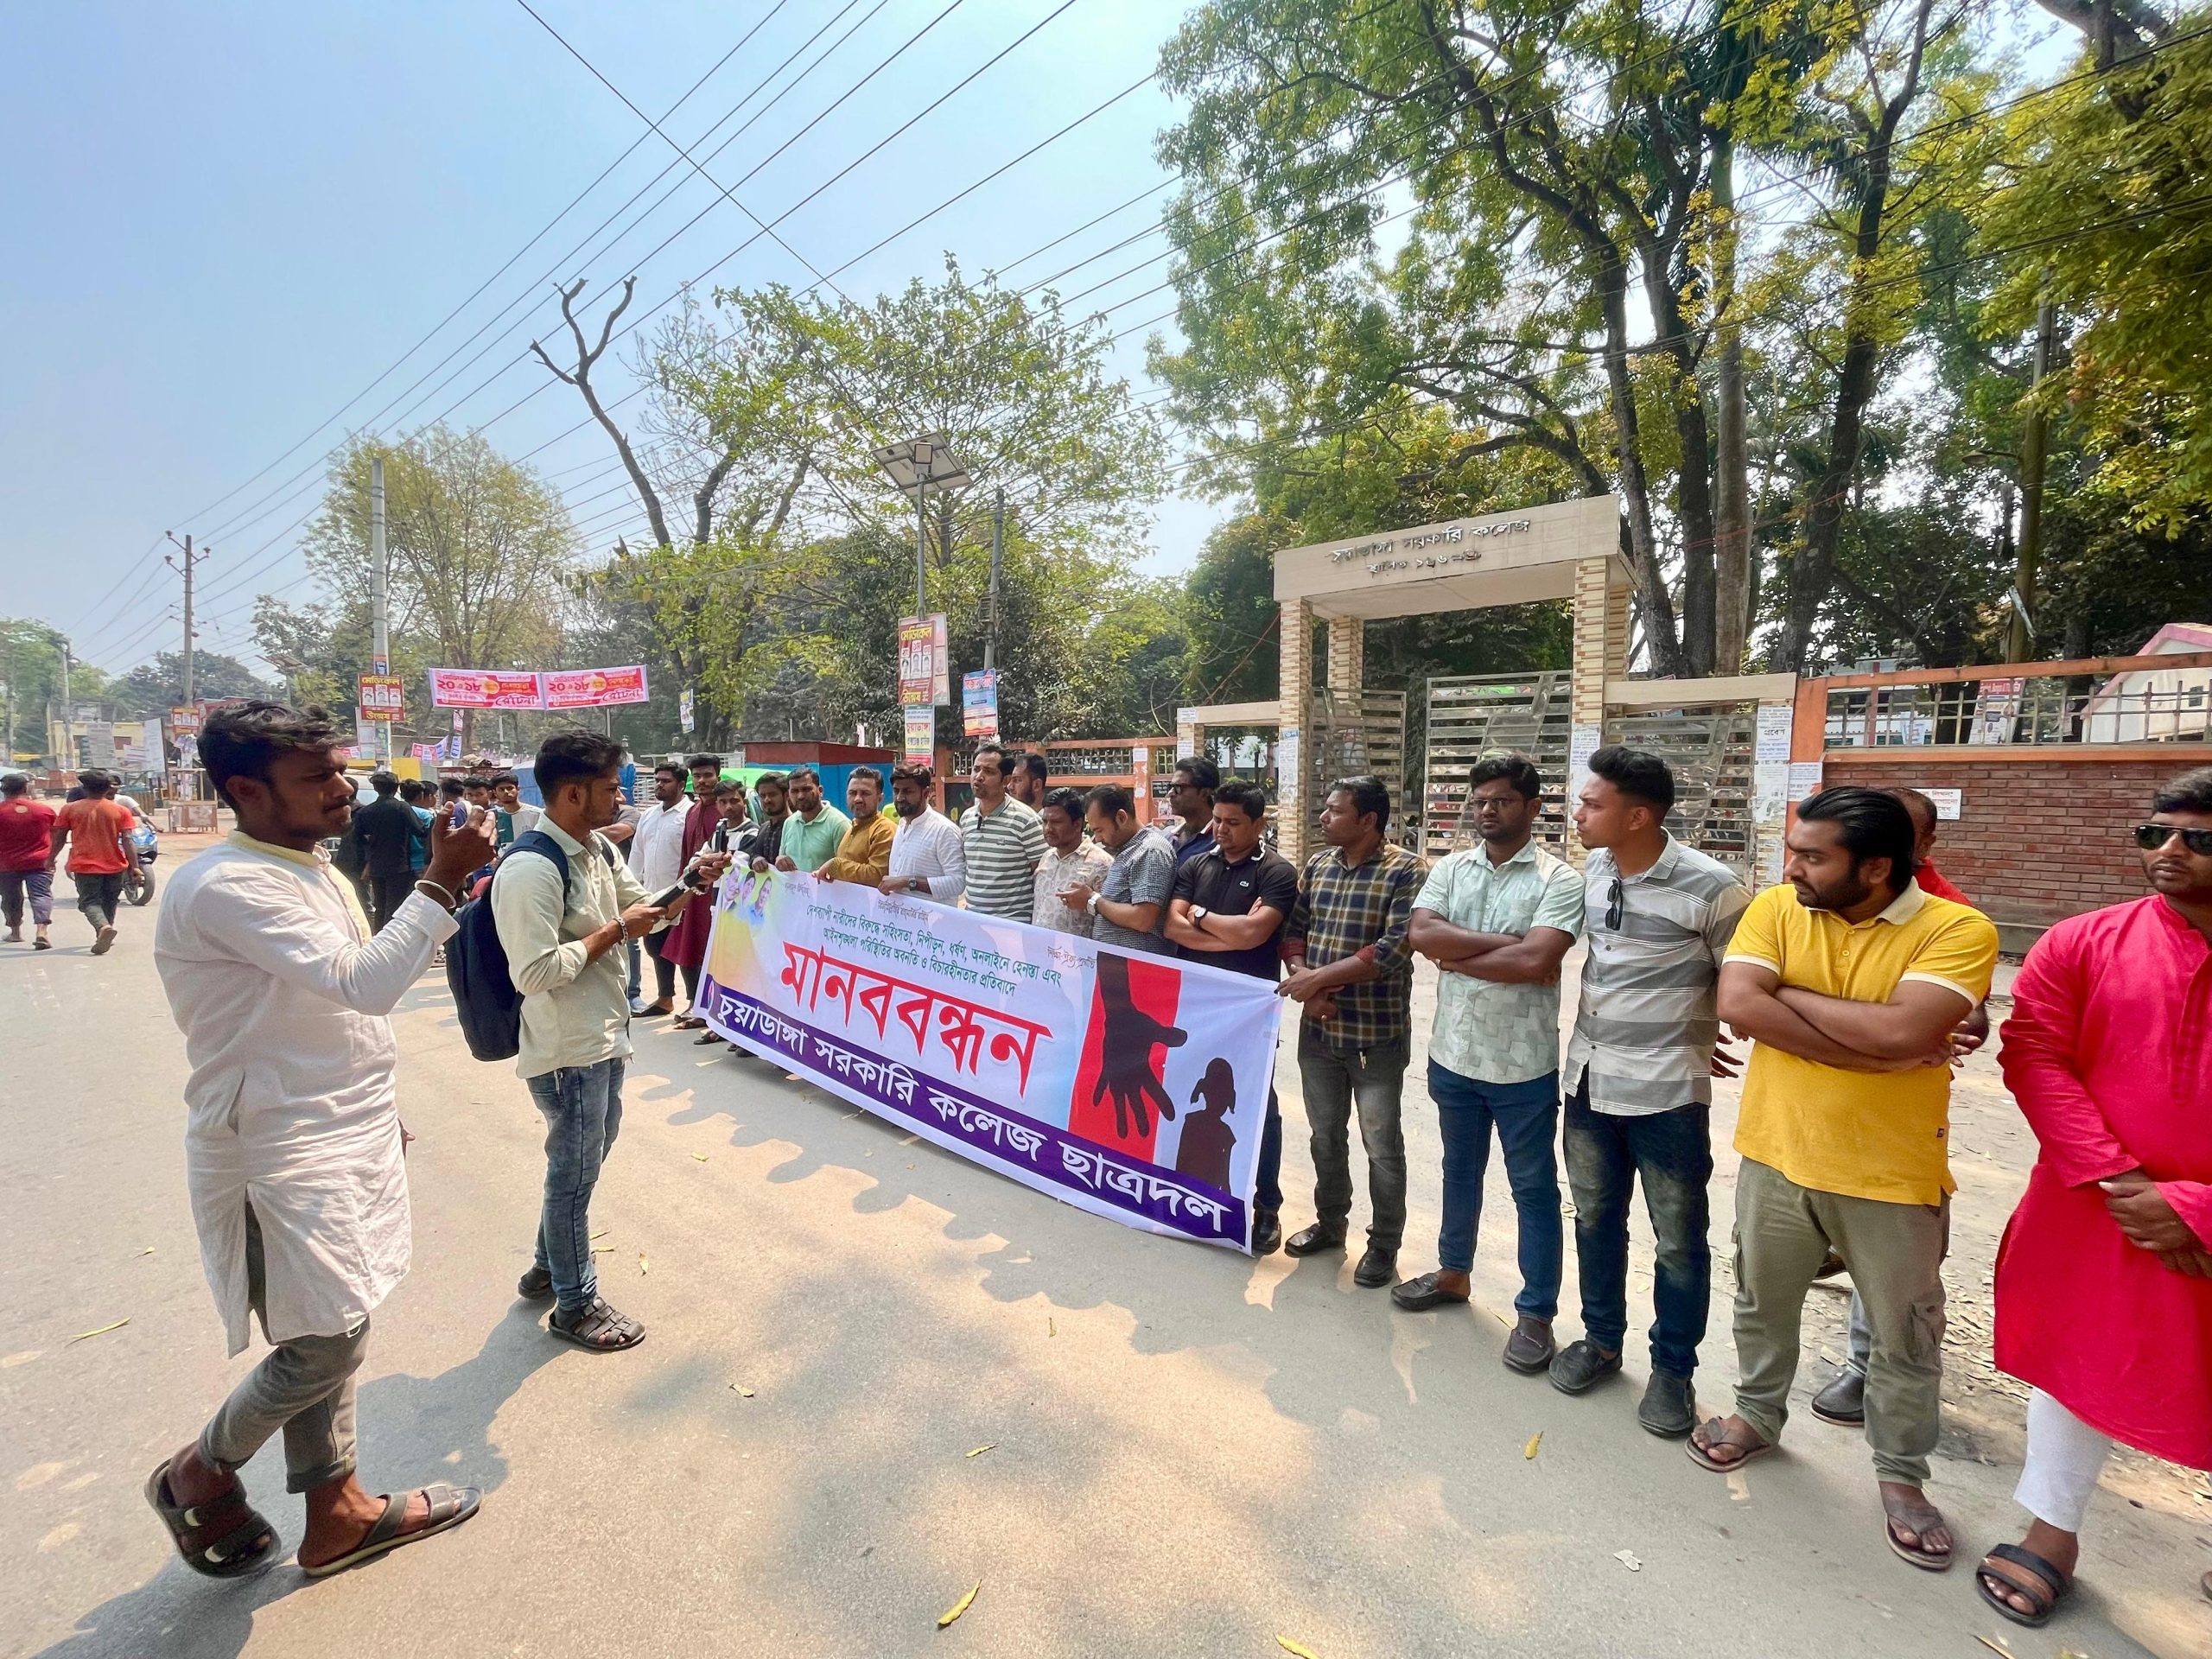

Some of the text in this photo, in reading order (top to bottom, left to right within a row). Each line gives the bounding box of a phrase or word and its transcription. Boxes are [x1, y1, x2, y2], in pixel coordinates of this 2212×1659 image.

[1471, 519, 1530, 537] কলেজ
[437, 680, 454, 690] ২০
[465, 682, 482, 691] ১৮
[549, 683, 565, 692] ২০
[575, 682, 589, 691] ১৮
[806, 905, 1061, 988] দেশব্যাপী নারীদের বিরুদ্ধে সহিংসতা, নিপীড়ন, ধর্ষণ, অনলাইনে হেনস্তা এবং
[860, 937, 893, 958] পরিস্থিতির
[893, 947, 919, 968] অবনতি
[921, 957, 928, 969] ও
[929, 955, 979, 985] বিচারহীনতার
[979, 971, 1017, 997] প্রতিবাদে
[780, 941, 1053, 1099] মানববন্ধন
[717, 993, 1234, 1233] চুয়াডাঙ্গা সরকারি কলেজ ছাত্রদল
